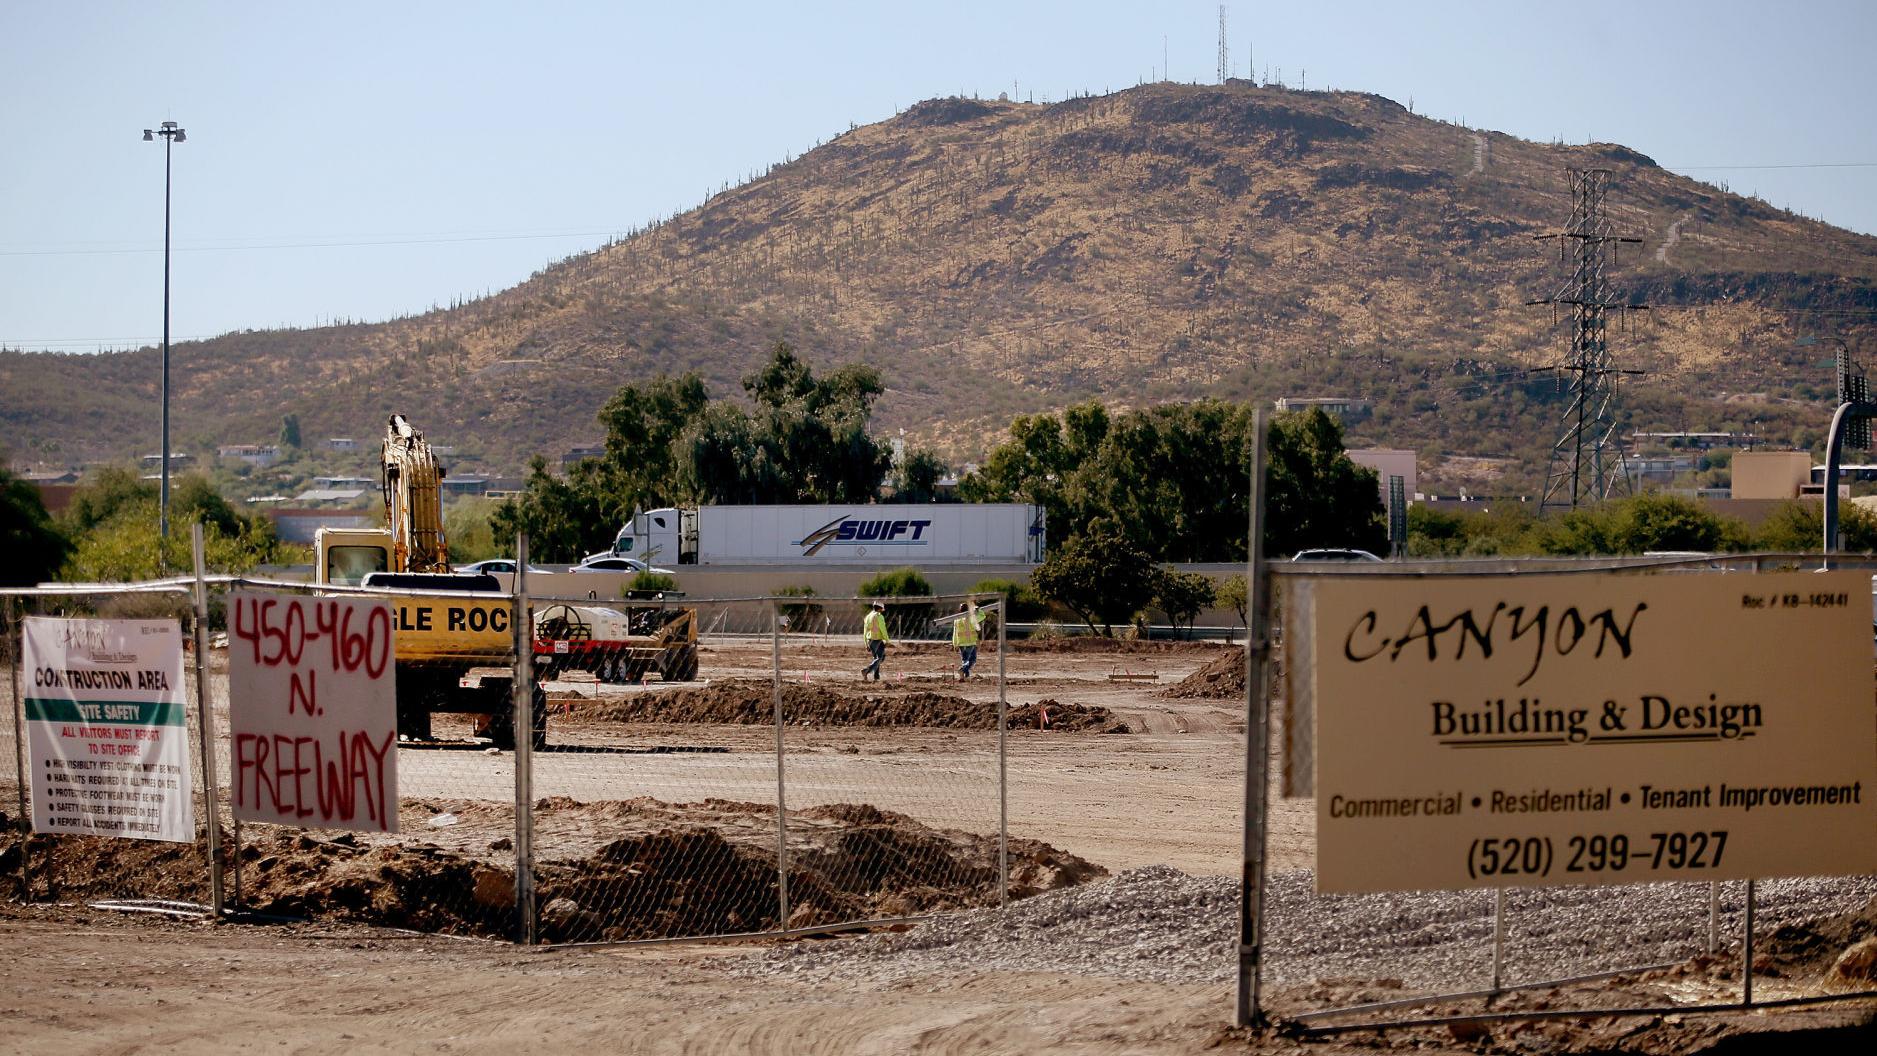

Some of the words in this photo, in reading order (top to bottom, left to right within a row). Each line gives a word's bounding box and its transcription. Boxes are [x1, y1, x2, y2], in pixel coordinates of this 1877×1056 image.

[836, 519, 931, 540] SWIFT
[392, 607, 432, 631] LE
[448, 607, 513, 632] ROC
[235, 597, 391, 680] 450-460
[1344, 602, 1648, 687] CANYON
[138, 671, 169, 691] AREA
[288, 669, 324, 717] N.
[80, 704, 101, 720] SITE
[105, 705, 140, 721] SAFETY
[1432, 699, 1588, 744] Building
[1600, 702, 1627, 731] &
[1641, 693, 1763, 740] Design
[62, 726, 76, 738] ALL
[114, 728, 133, 740] MUST
[88, 743, 99, 755] TO
[101, 744, 116, 755] SITE
[236, 730, 395, 832] FREEWAY
[56, 788, 88, 799] PROTEIVE
[1330, 791, 1462, 819] Commercial
[1491, 788, 1611, 815] Residential
[1640, 786, 1711, 810] Tenant
[1719, 782, 1861, 812] Improvement
[57, 802, 79, 813] SAFETY
[57, 817, 80, 828] REPORT
[1467, 836, 1553, 879] (520)
[1567, 831, 1729, 873] 299-7927
